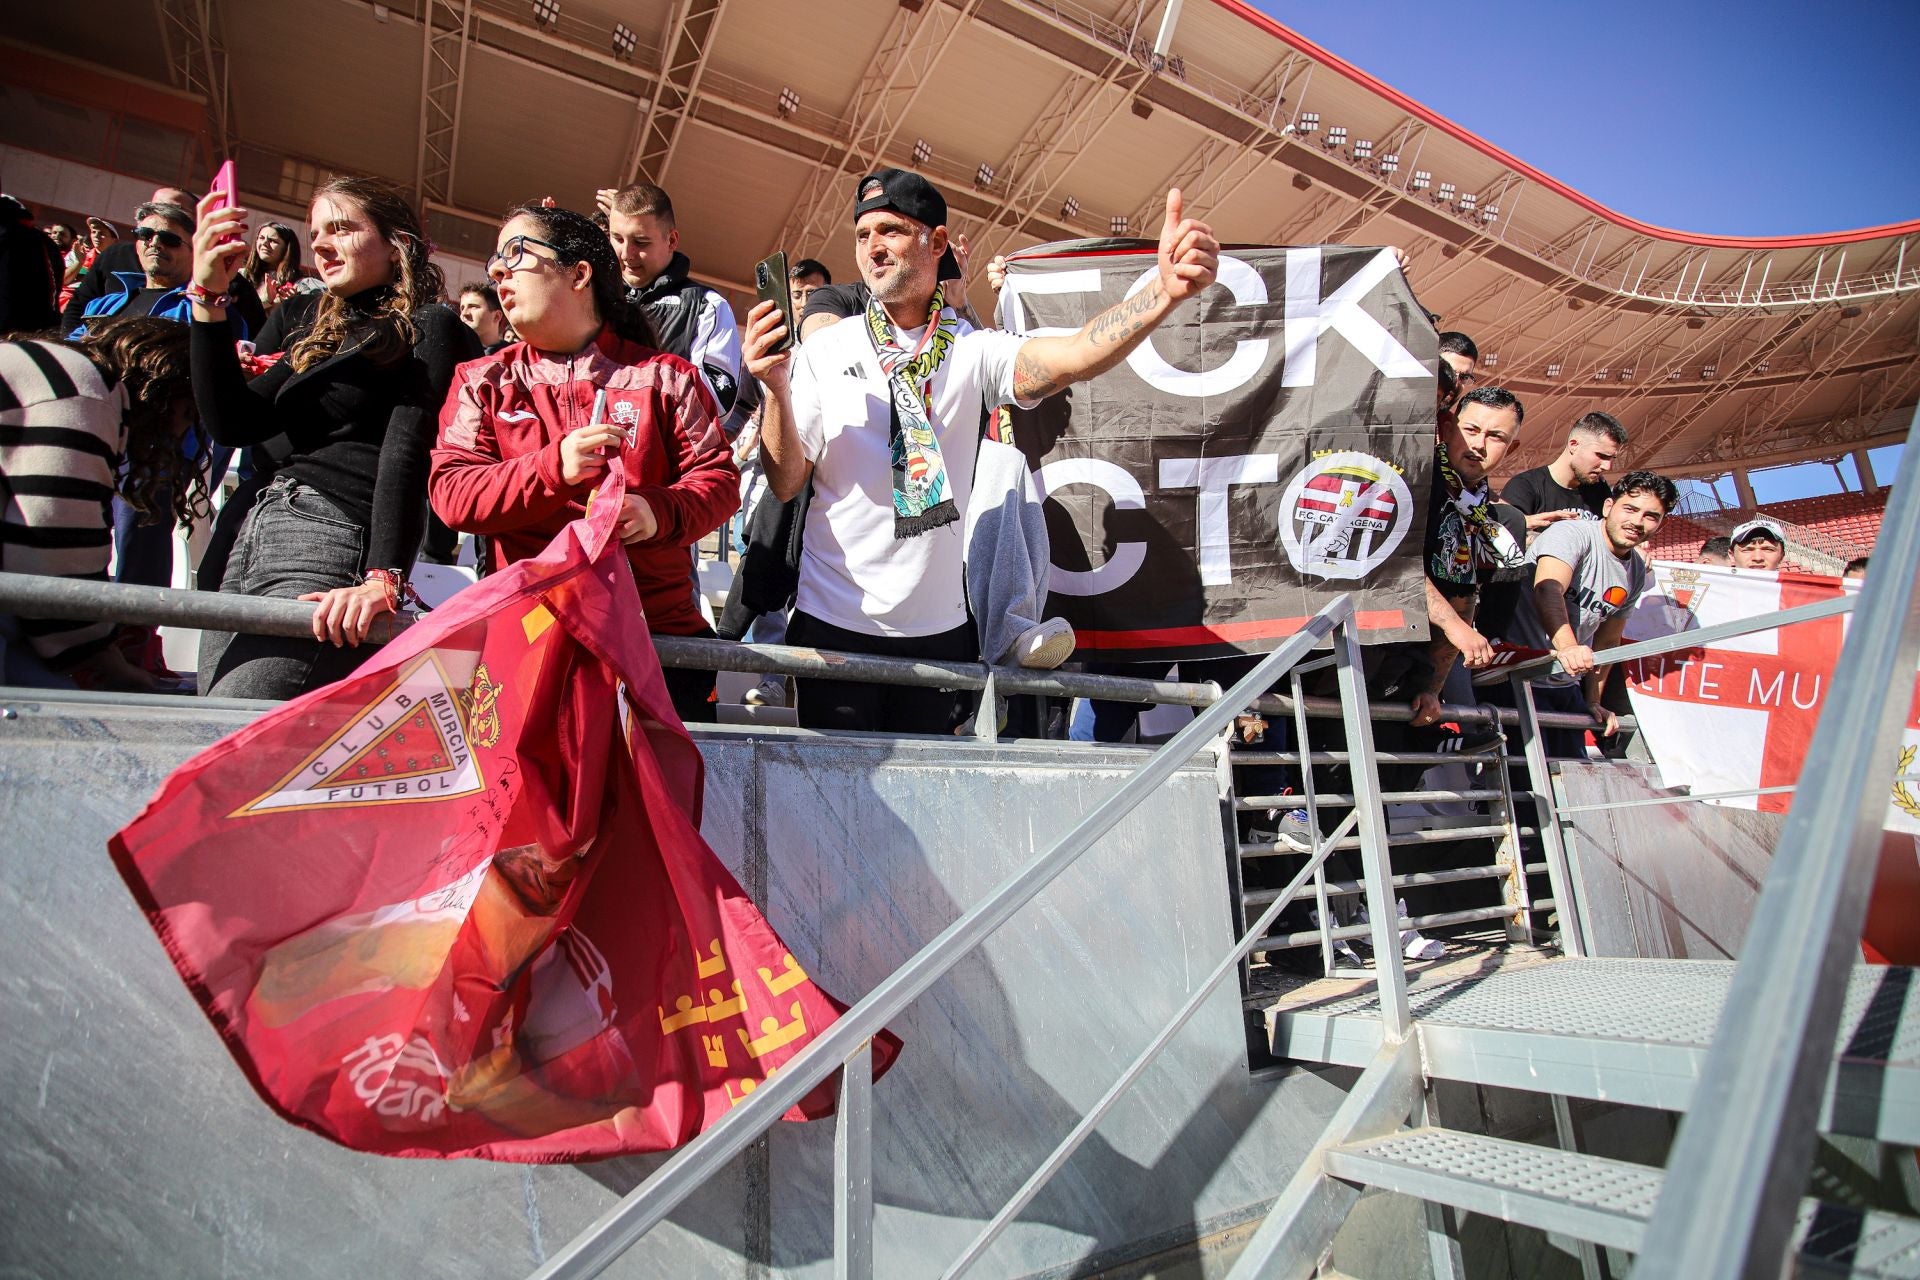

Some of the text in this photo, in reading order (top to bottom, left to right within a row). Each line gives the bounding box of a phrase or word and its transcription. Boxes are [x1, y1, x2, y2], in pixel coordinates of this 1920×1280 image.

[1319, 513, 1383, 529] CAGENA
[1747, 667, 1821, 710] MU
[312, 694, 412, 776] CLUB
[430, 692, 468, 766] MURCIA
[328, 776, 450, 801] FUTBOL
